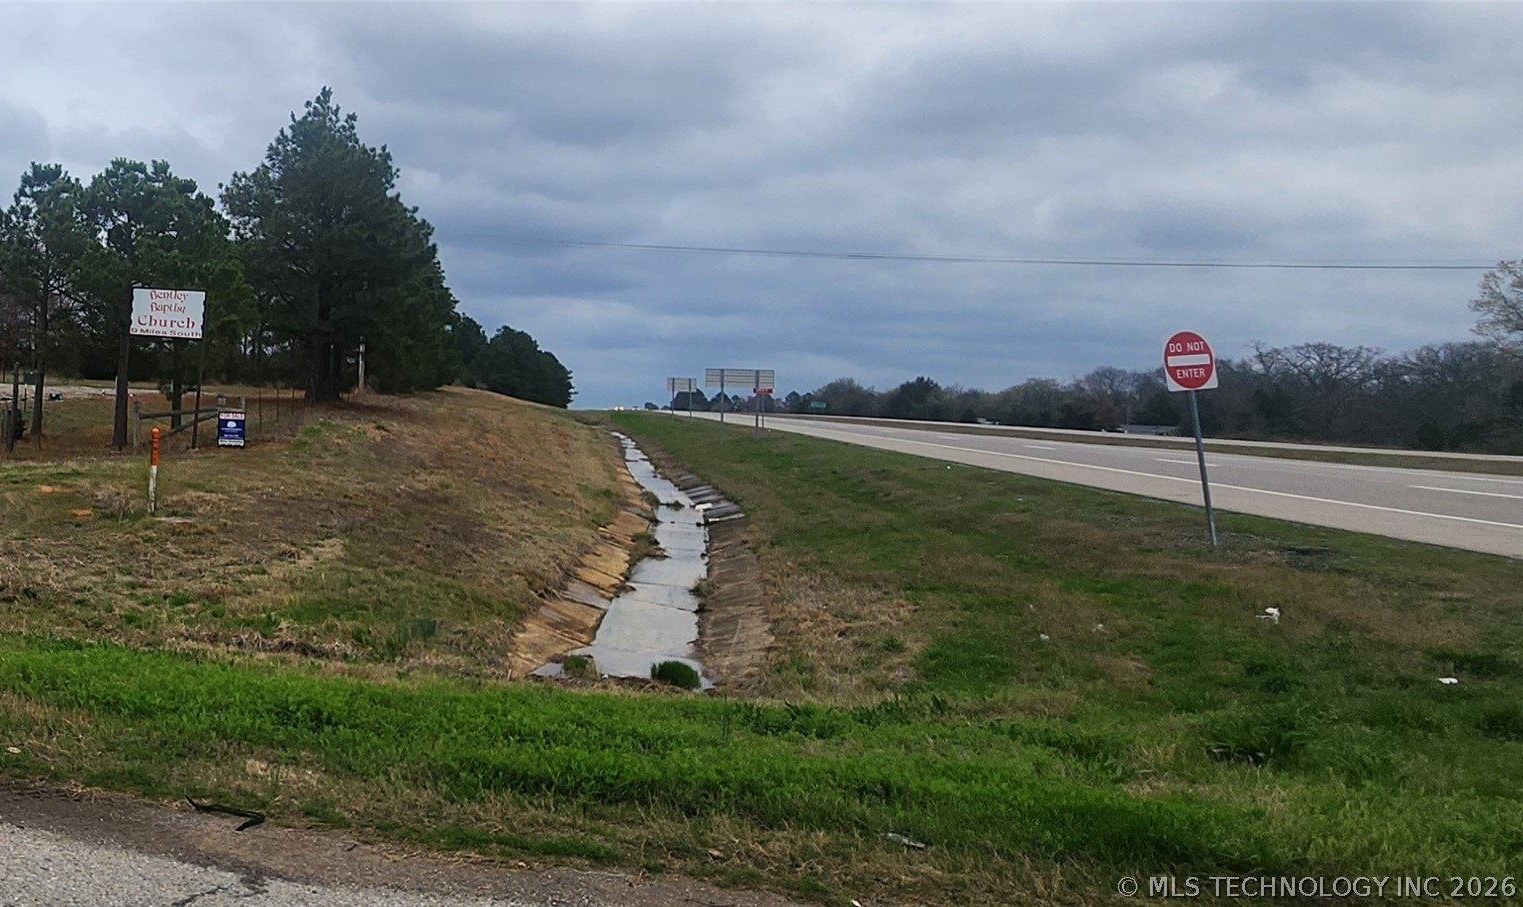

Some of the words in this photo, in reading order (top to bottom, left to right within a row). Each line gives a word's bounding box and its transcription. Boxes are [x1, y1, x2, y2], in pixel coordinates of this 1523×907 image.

[150, 290, 188, 303] Bentley
[150, 302, 186, 314] Baptist
[137, 315, 195, 329] Church
[1169, 343, 1182, 353] DO
[1186, 341, 1204, 352] NOT
[1176, 368, 1206, 379] ENTER
